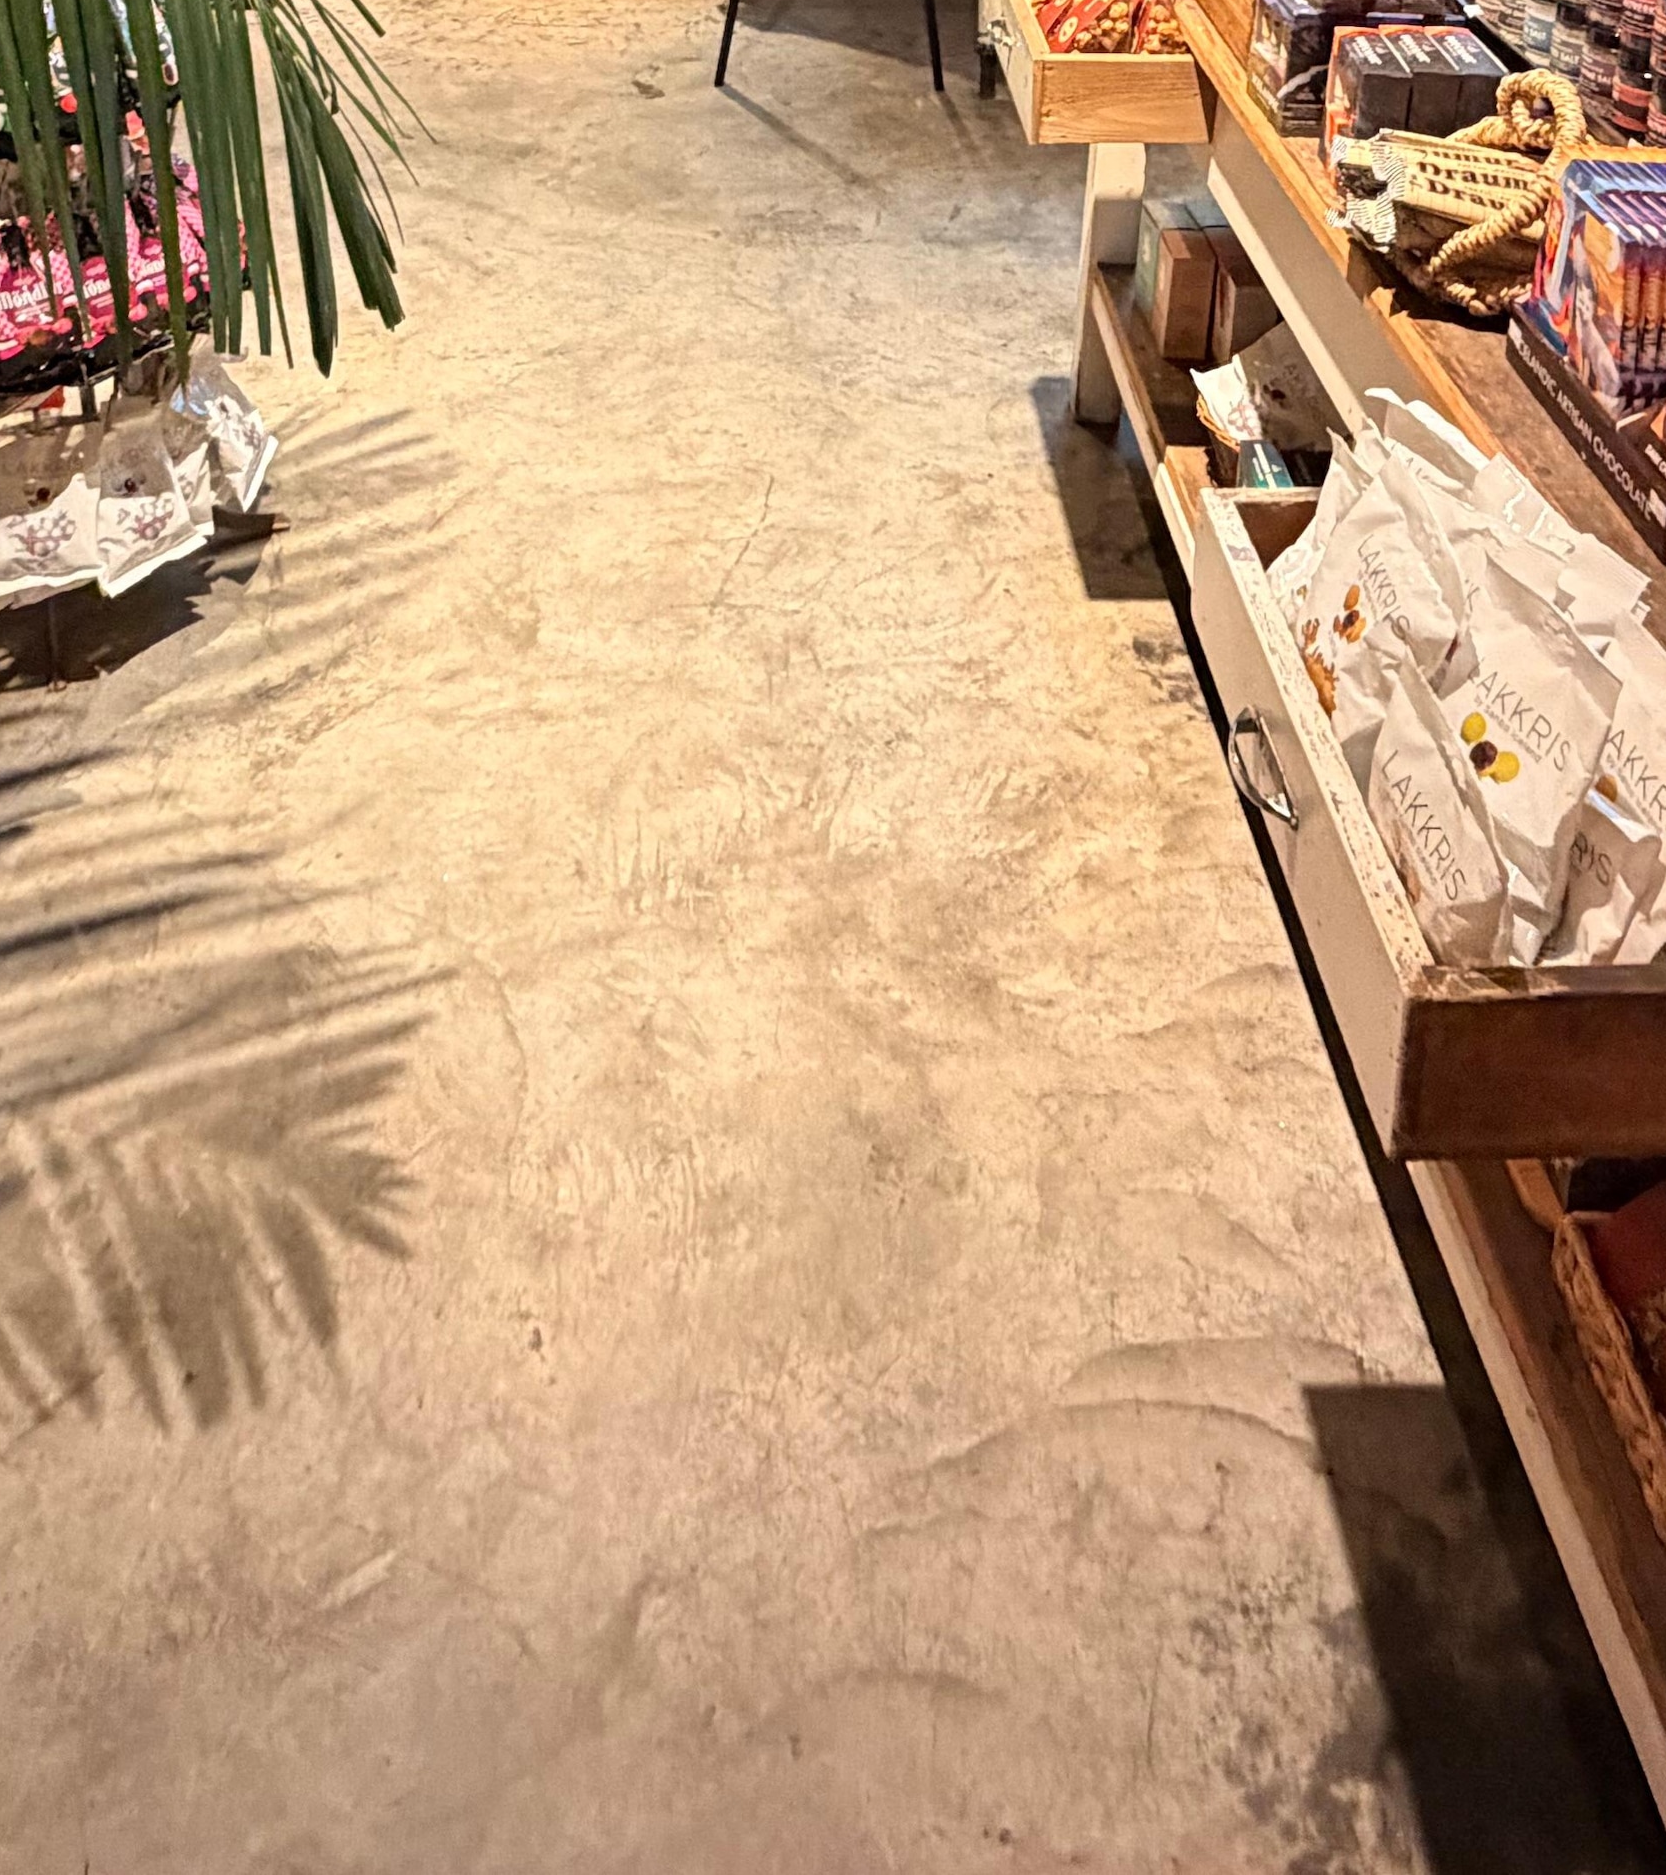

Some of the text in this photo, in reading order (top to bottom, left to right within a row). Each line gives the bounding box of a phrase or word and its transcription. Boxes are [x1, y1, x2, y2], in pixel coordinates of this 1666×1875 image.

[1559, 51, 1581, 65] SALT
[1556, 389, 1594, 446] ARTISAN
[1357, 533, 1412, 641] LAKKRIS
[1381, 748, 1467, 903] LAKKRIS
